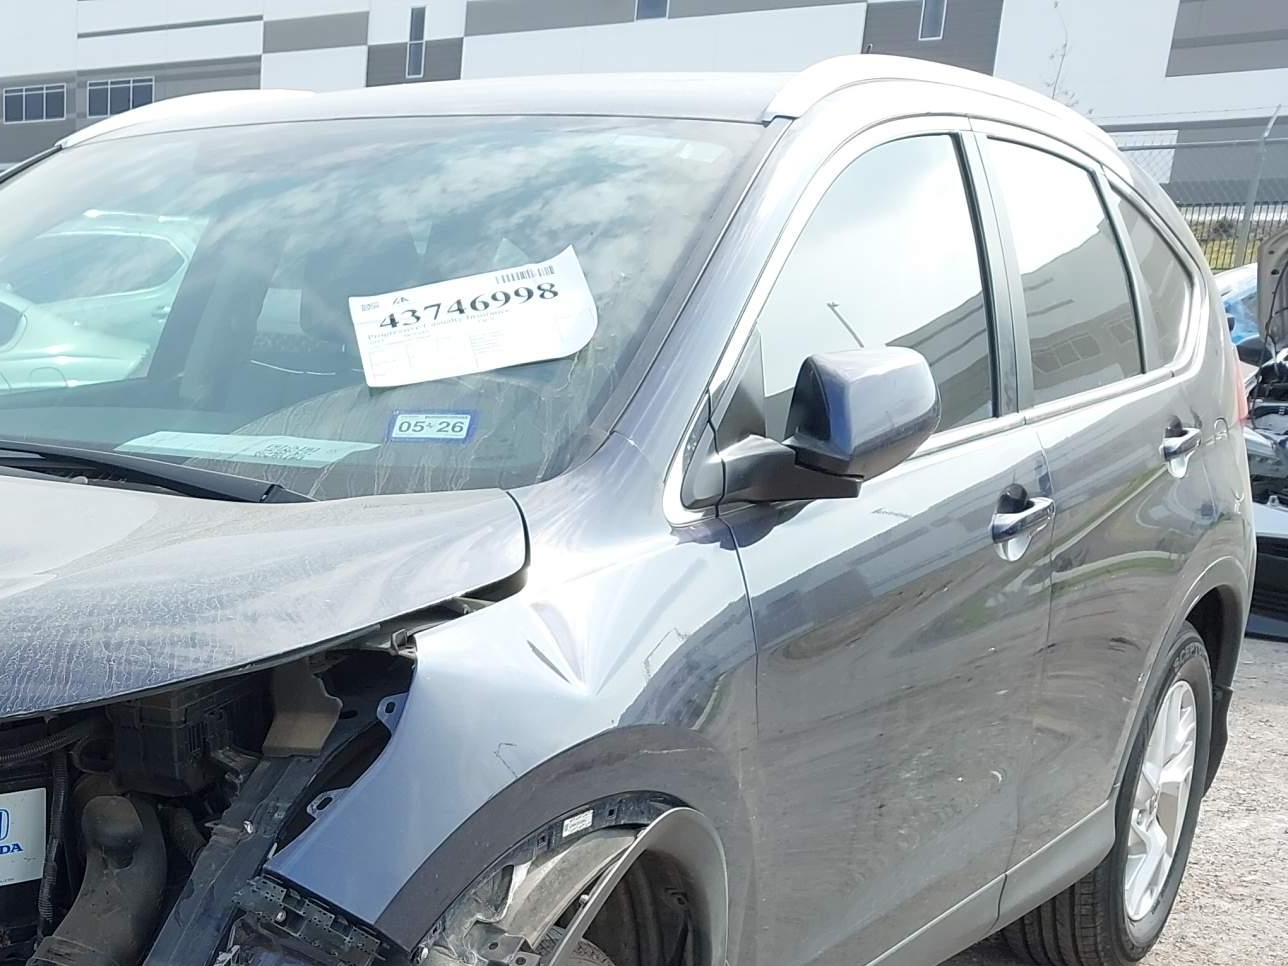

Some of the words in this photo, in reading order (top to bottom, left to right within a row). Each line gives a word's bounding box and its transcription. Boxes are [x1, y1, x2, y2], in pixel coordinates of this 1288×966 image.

[379, 282, 559, 329] 43746998
[398, 420, 425, 433] 05
[436, 420, 465, 433] 26
